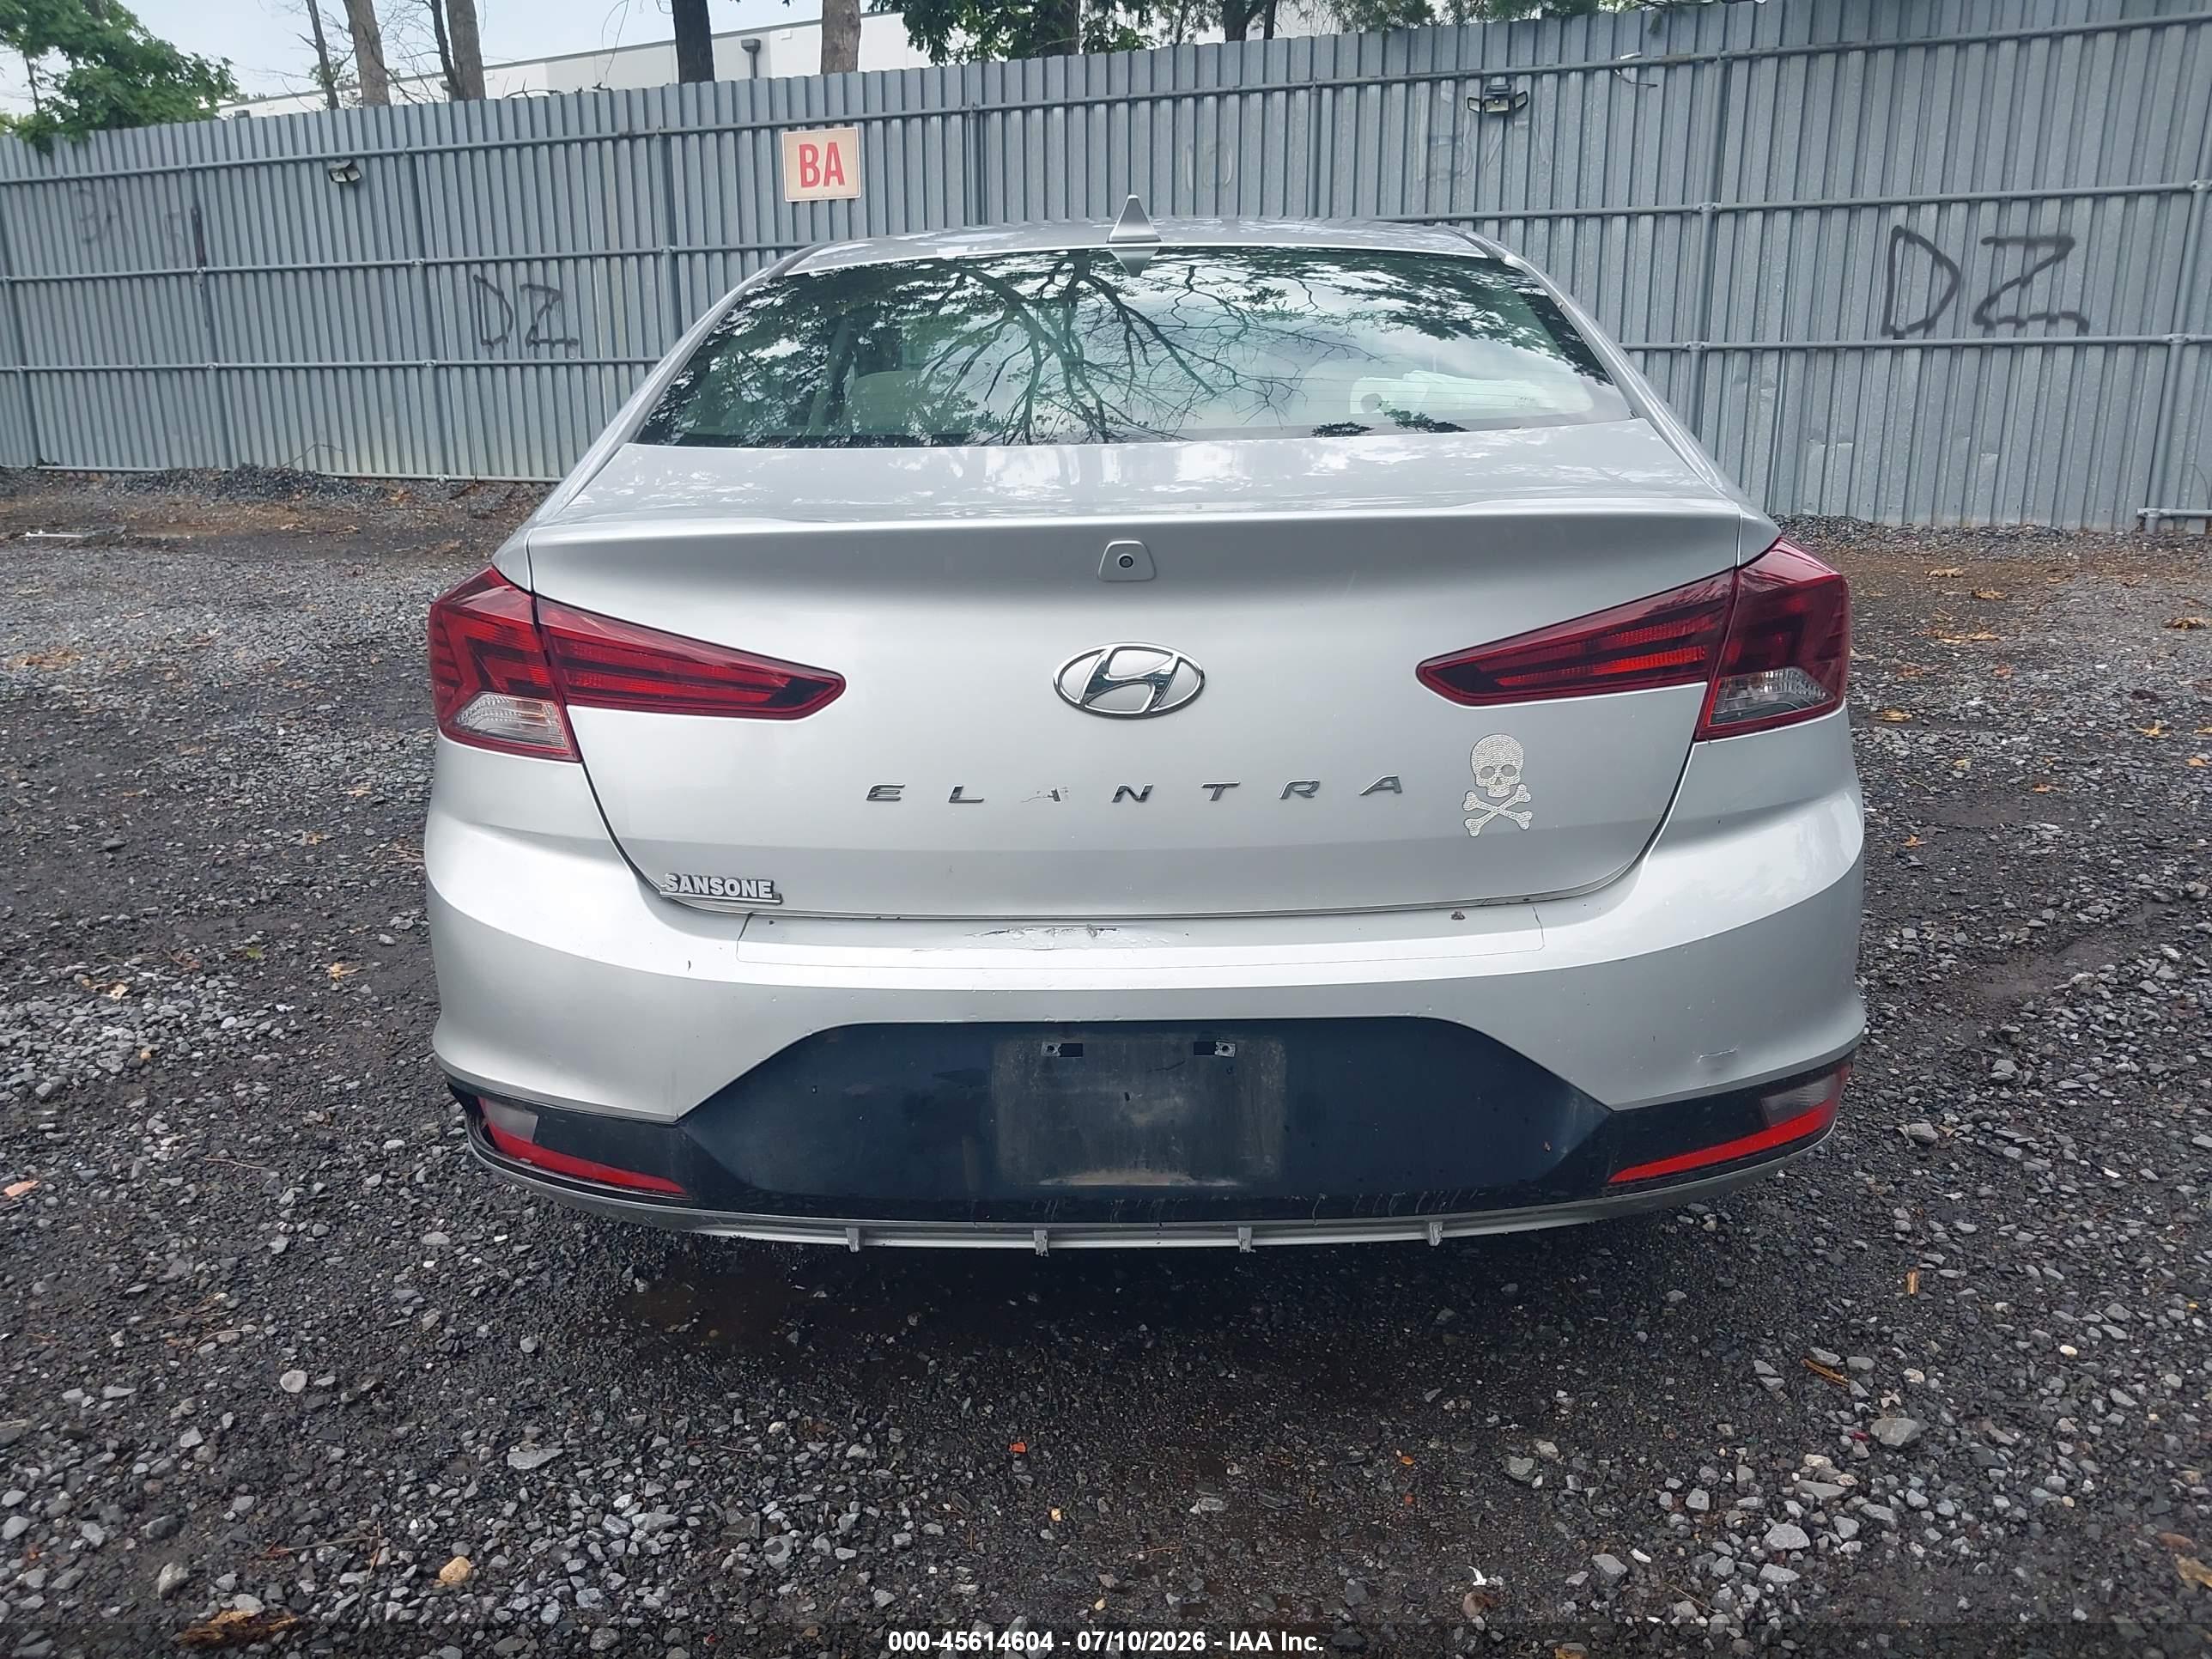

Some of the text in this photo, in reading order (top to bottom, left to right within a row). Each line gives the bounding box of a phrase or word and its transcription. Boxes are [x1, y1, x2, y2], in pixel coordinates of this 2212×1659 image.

[799, 141, 846, 189] BA
[473, 273, 580, 348] DZ
[1881, 225, 2090, 338] DZ
[664, 872, 774, 899] SANSONE
